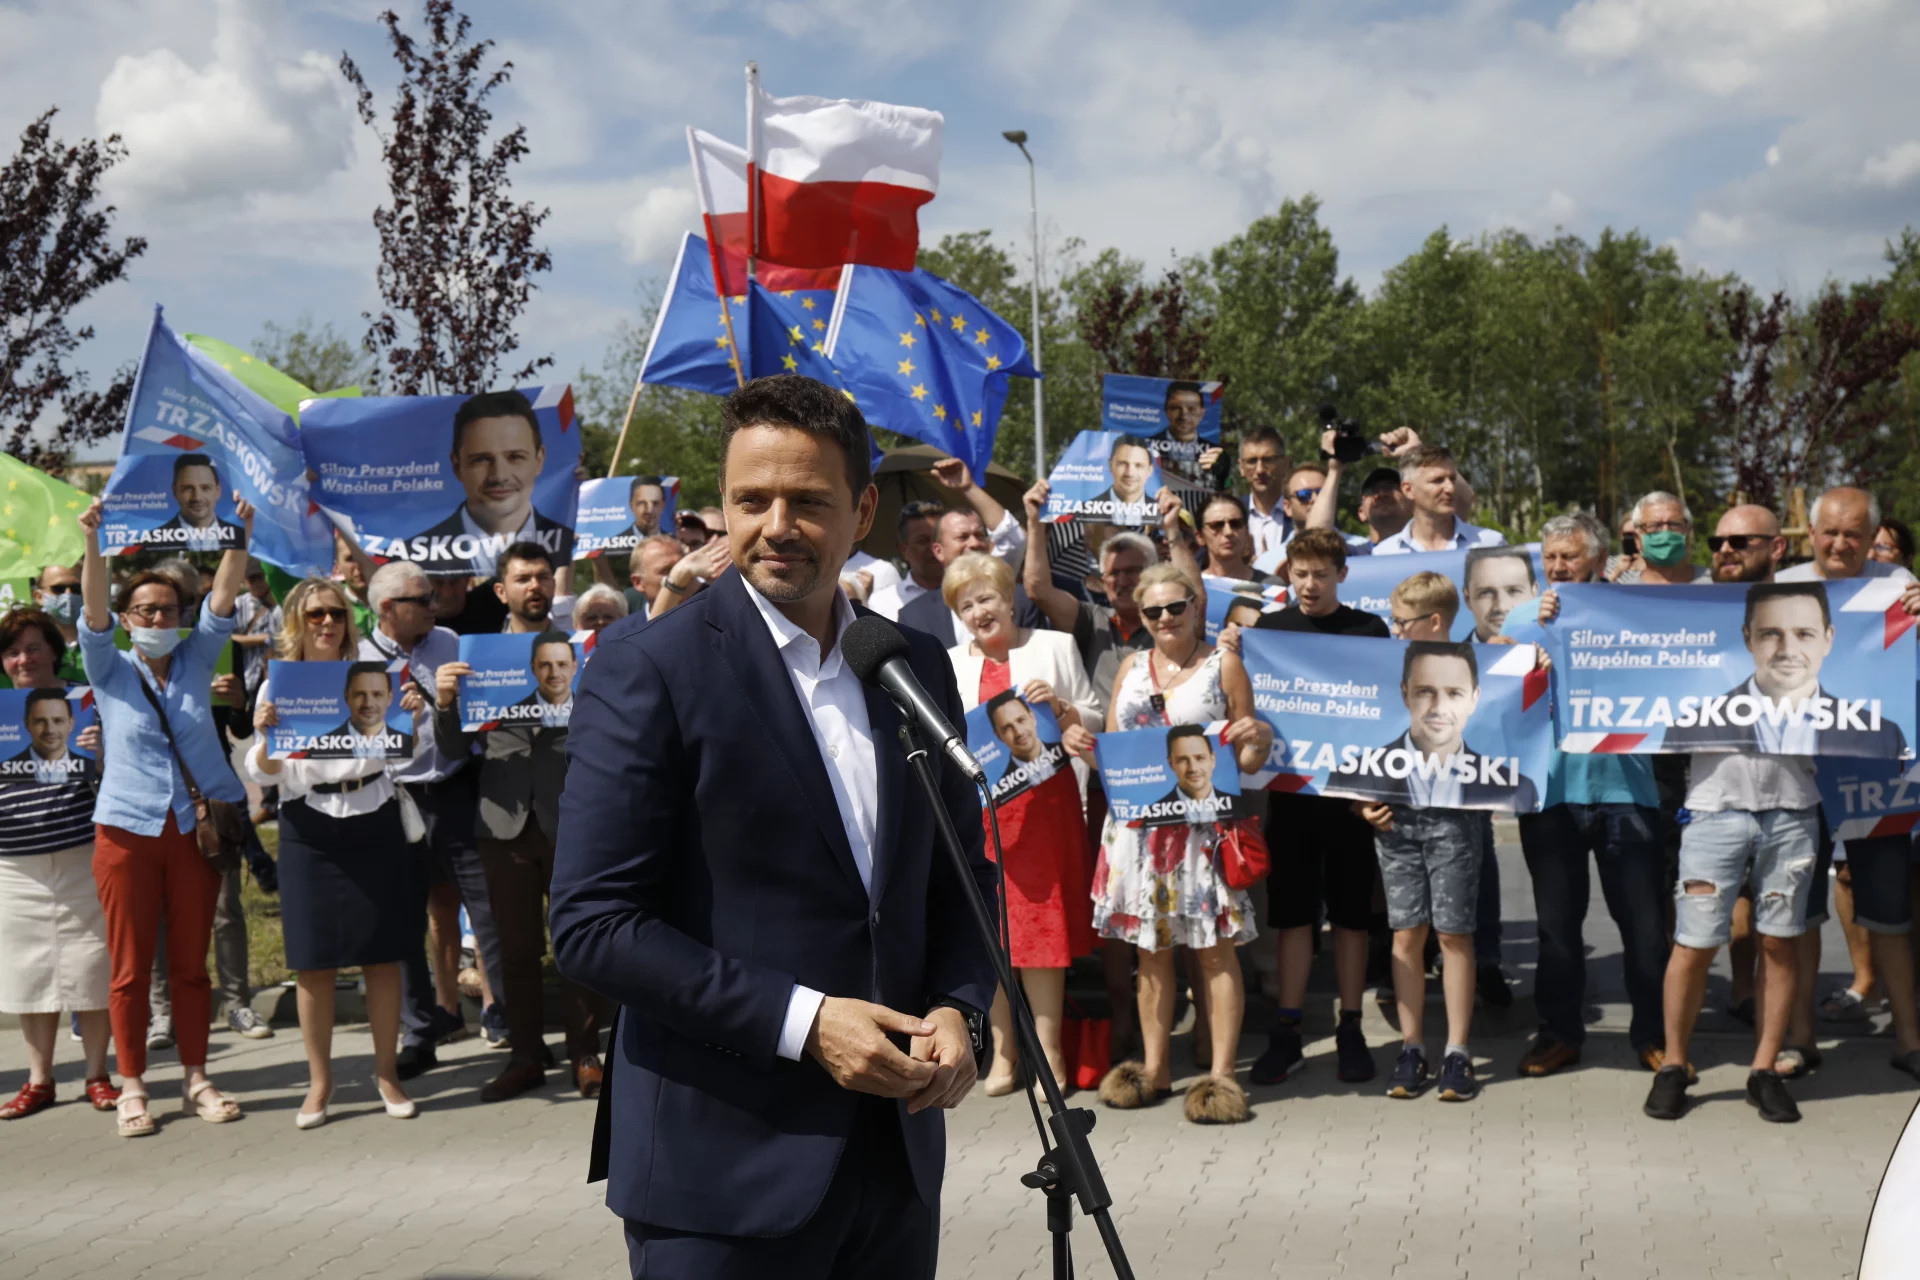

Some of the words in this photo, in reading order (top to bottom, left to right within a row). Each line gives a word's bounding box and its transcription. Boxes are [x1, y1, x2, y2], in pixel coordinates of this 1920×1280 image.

[1145, 438, 1210, 454] KOWSKI
[156, 400, 301, 514] TRZASKOWSK
[320, 462, 356, 478] Silny
[361, 461, 441, 478] Prezydent
[322, 477, 388, 495] Wspólna
[392, 477, 444, 492] Polska
[1047, 499, 1158, 517] TRZASKOWSKI
[105, 526, 236, 545] TRZASKOWSKI
[355, 528, 562, 562] ZASKOWKI
[577, 535, 639, 550] TRZASKO
[1571, 629, 1615, 649] Silny
[1619, 628, 1717, 648] Prezydent
[1571, 650, 1652, 670] Wspólna
[1657, 649, 1721, 668] Polska
[1252, 673, 1290, 693] Silny
[1294, 677, 1379, 698] Prezydent
[467, 704, 573, 721] TRZASKOWS
[1253, 693, 1321, 713] Wspólna
[1325, 699, 1381, 719] Polska
[1569, 695, 1882, 732] TRZASKOWSKI
[274, 734, 403, 751] TRZASKOWSKI
[0, 759, 85, 774] SKOWSKI
[984, 745, 1063, 800] ASKOWSKI
[1266, 738, 1520, 787] RZASKOWSKI
[1112, 796, 1232, 819] TRZASKOWSKI
